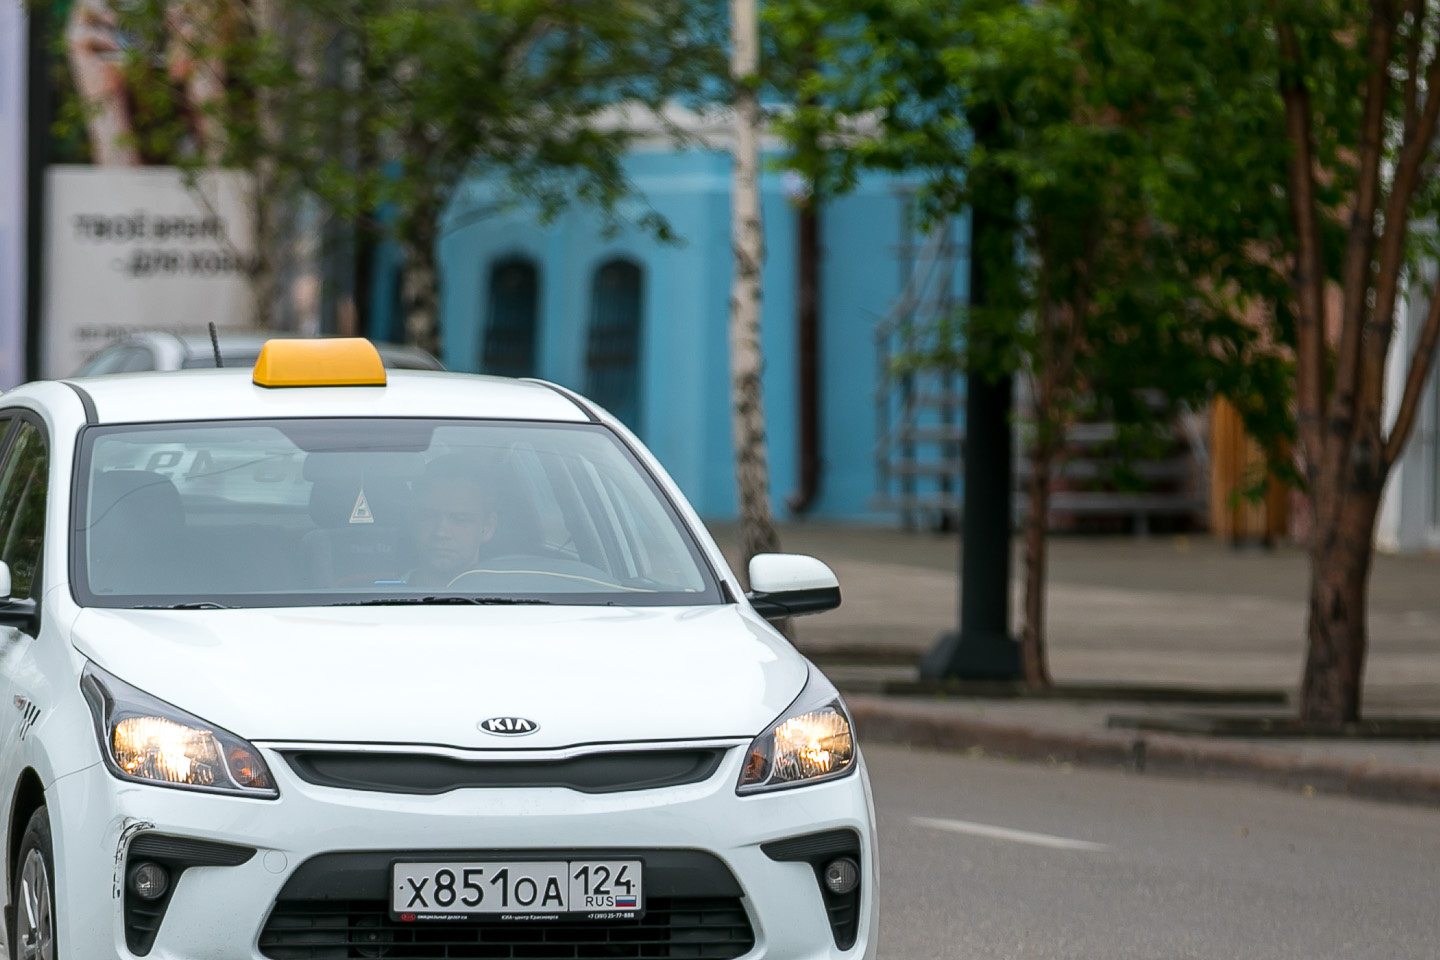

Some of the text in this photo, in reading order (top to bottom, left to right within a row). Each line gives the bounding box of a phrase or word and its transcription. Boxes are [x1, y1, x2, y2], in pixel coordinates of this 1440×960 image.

[488, 718, 532, 731] KIA
[573, 865, 632, 896] 124
[585, 895, 615, 907] RUS
